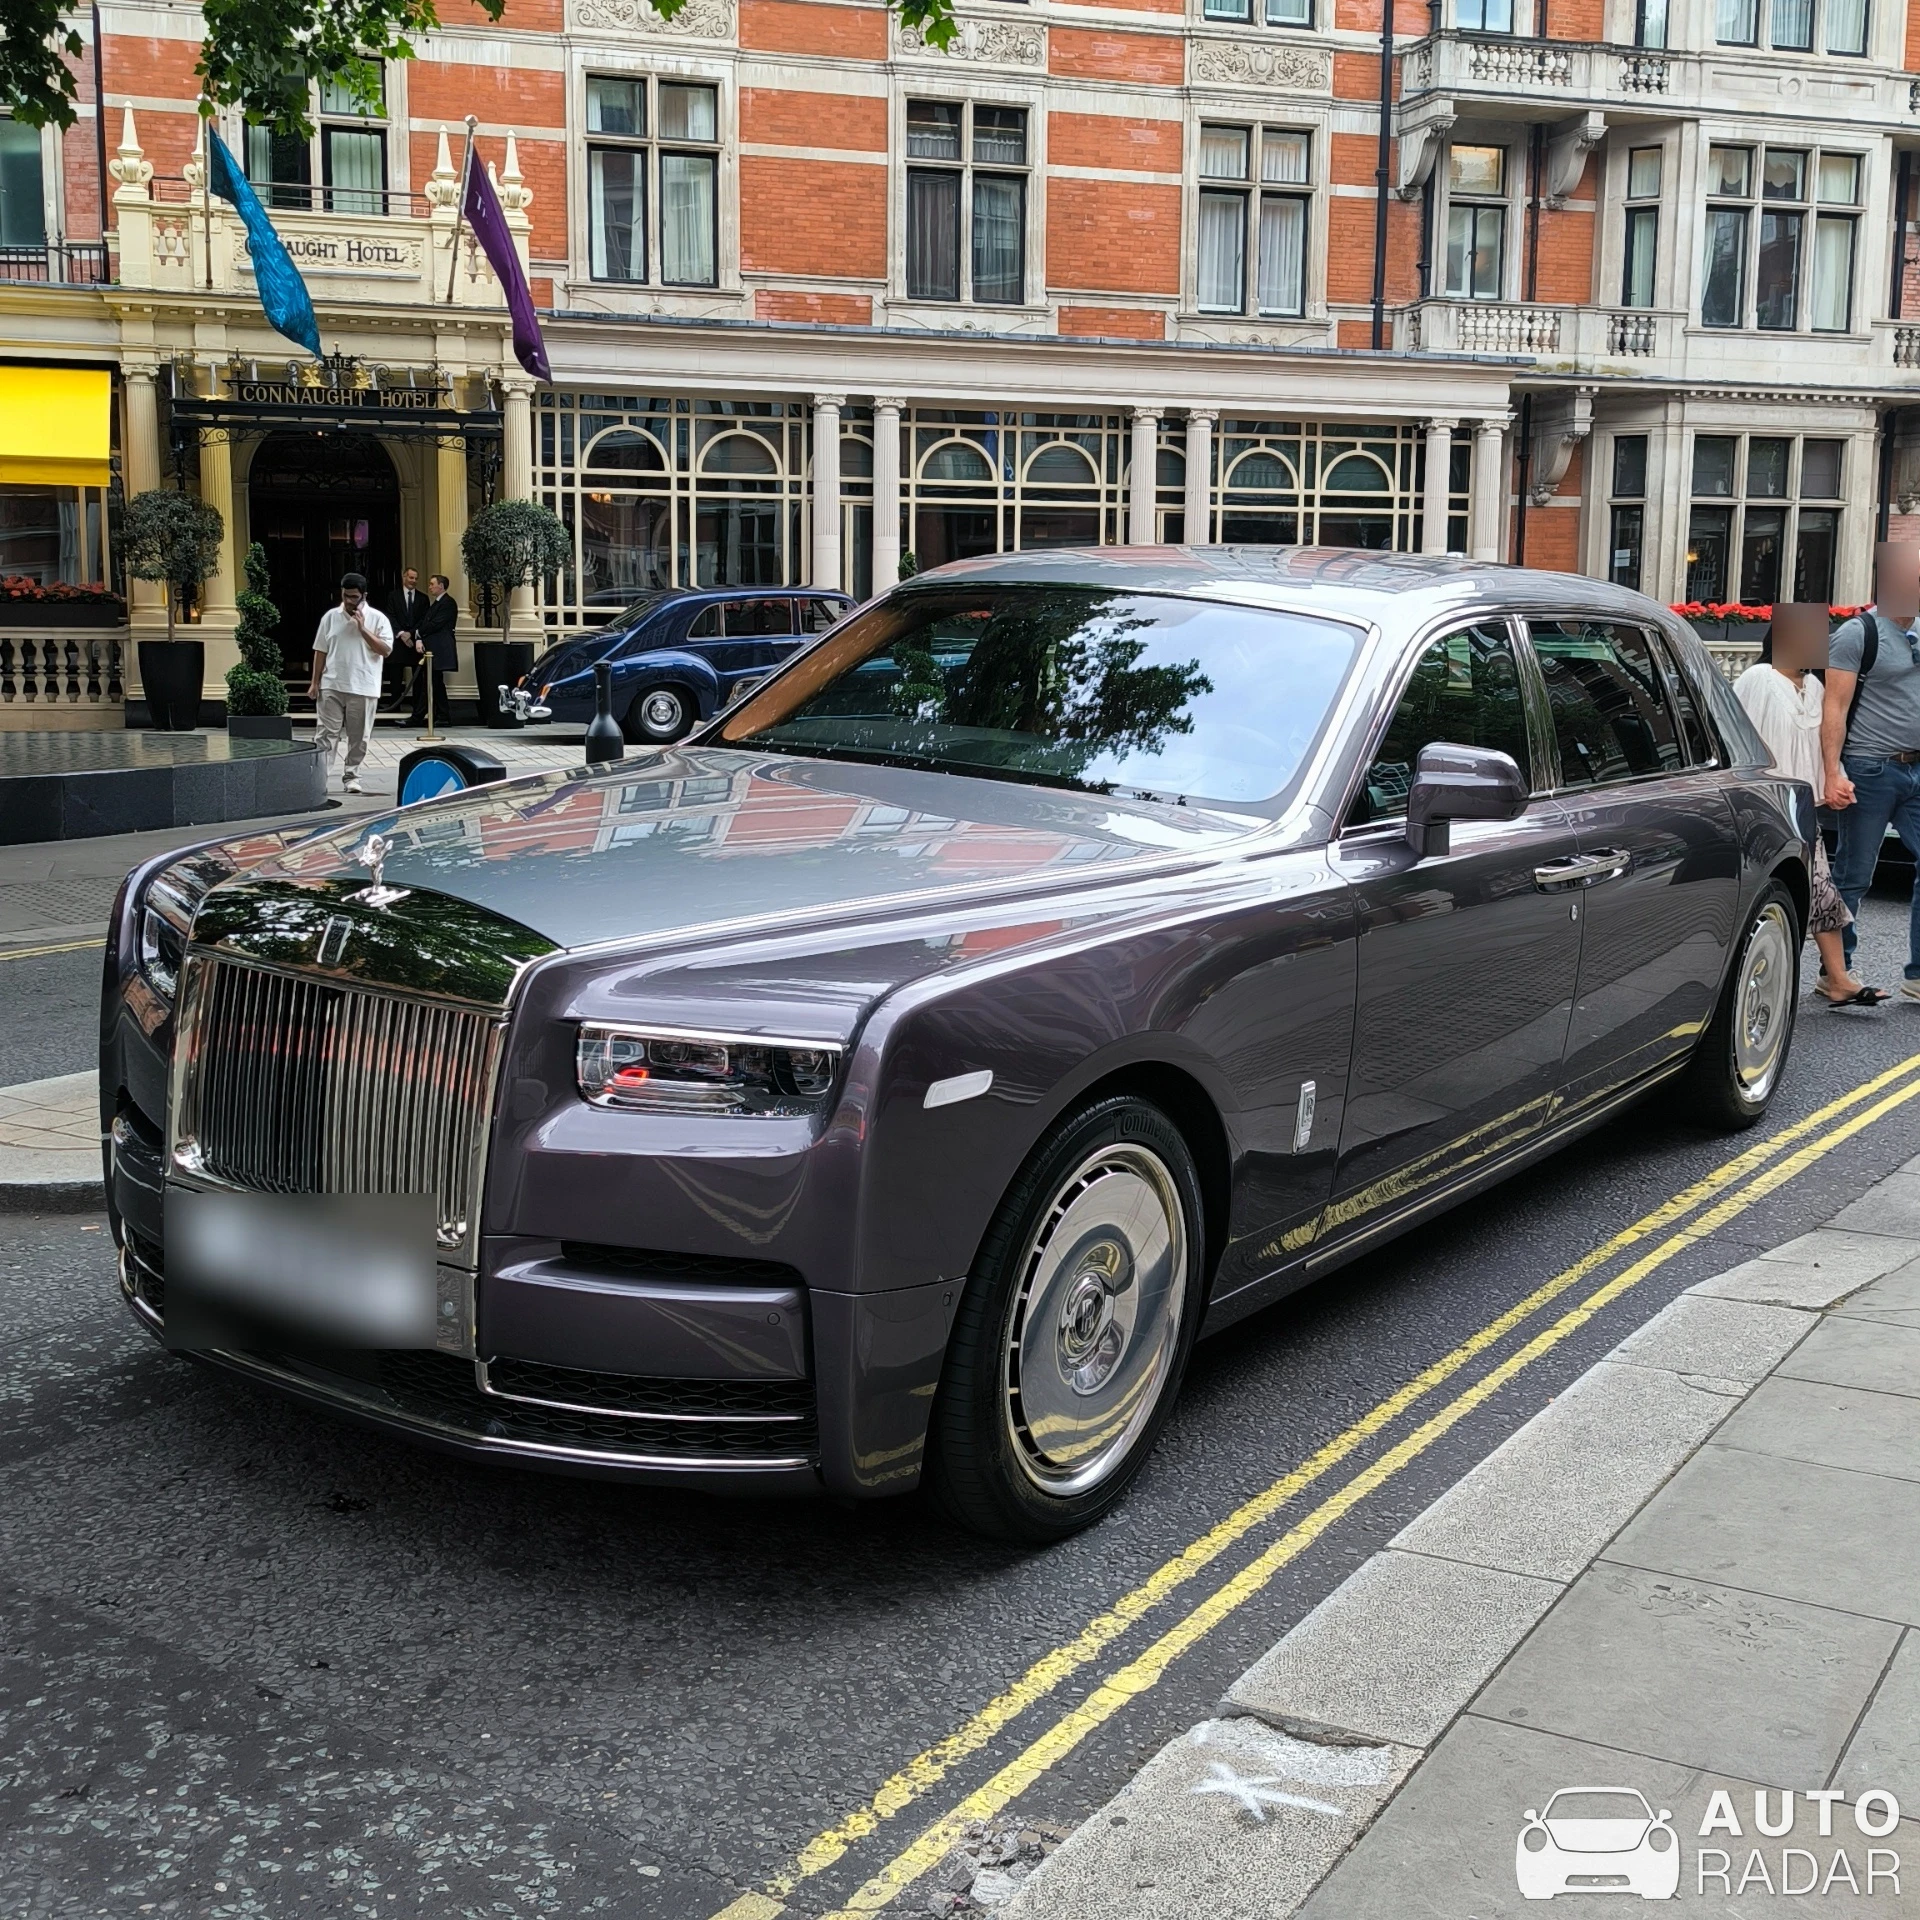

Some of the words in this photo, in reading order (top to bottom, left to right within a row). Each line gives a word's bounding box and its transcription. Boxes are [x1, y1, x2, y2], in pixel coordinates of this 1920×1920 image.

[347, 240, 408, 263] HOTEL
[325, 358, 351, 369] THE
[242, 385, 366, 407] CONNAUGHT
[380, 391, 437, 409] HOTEL
